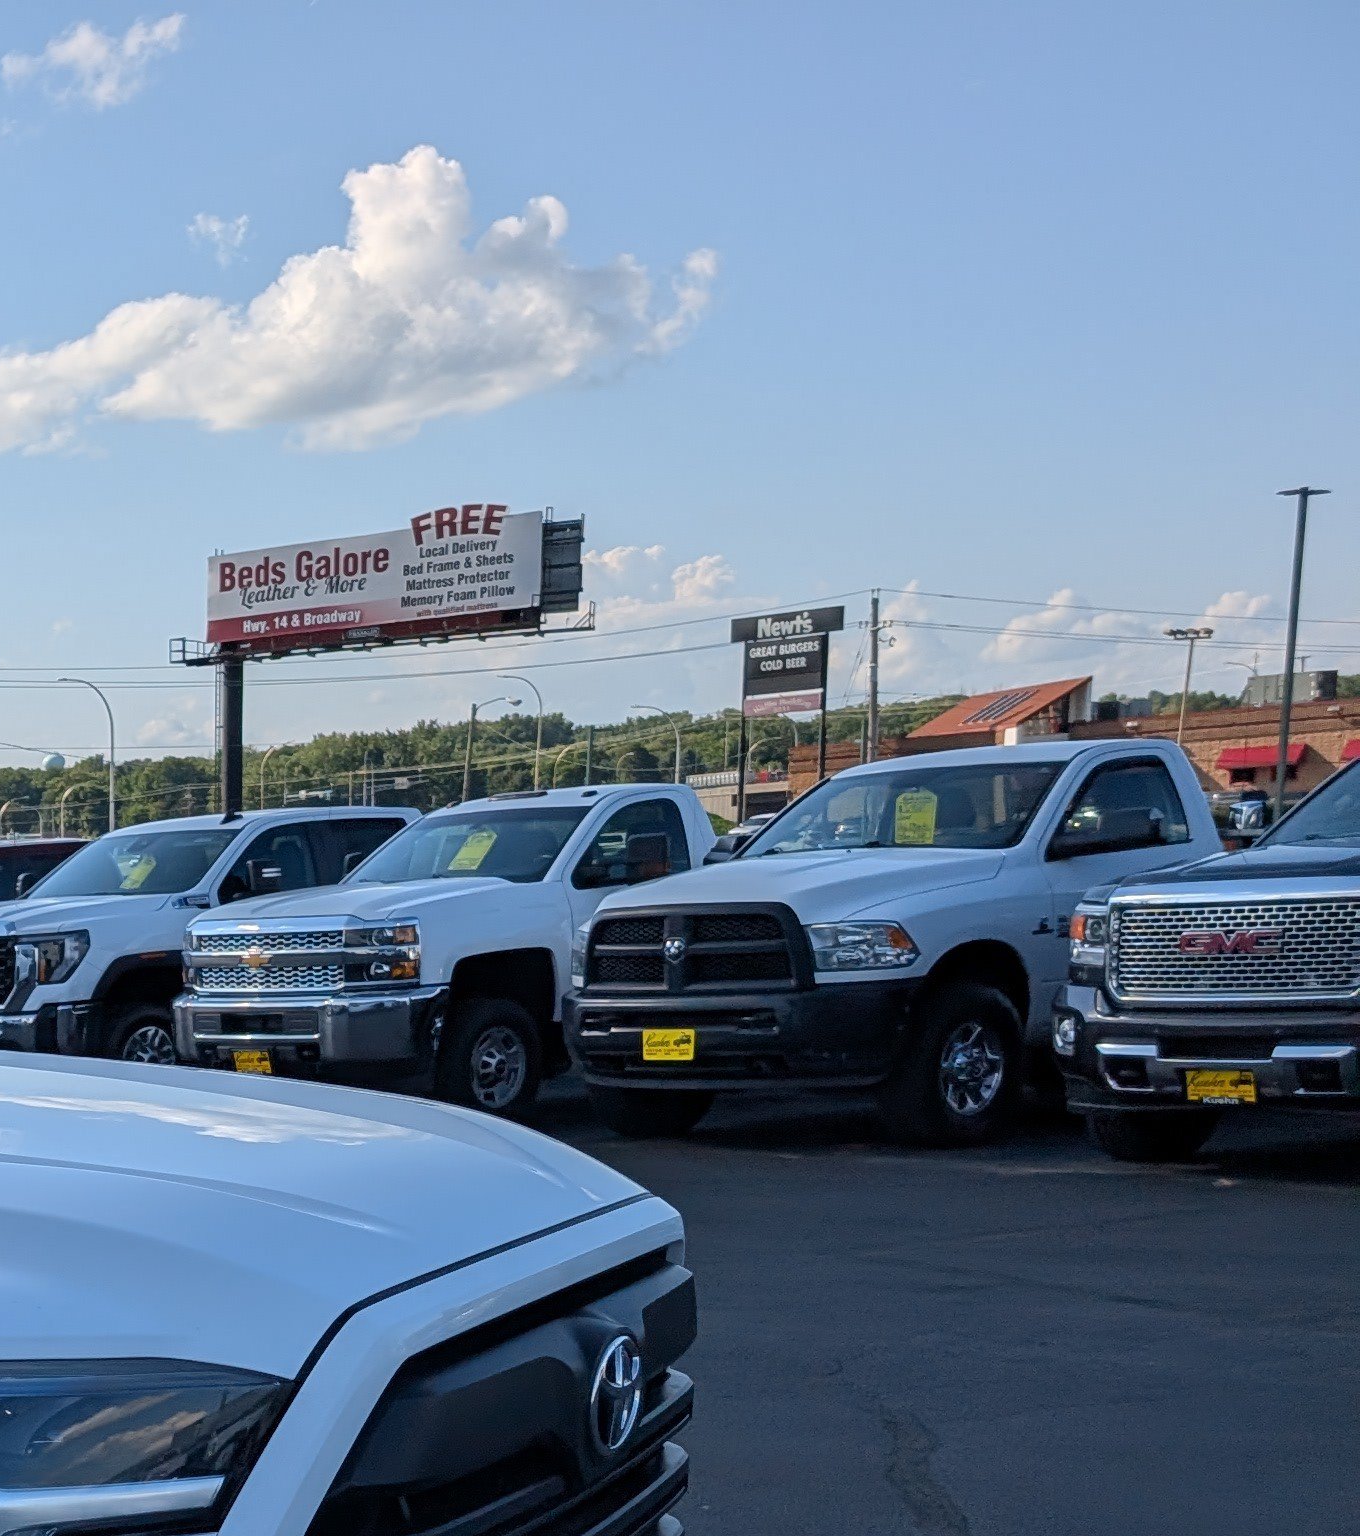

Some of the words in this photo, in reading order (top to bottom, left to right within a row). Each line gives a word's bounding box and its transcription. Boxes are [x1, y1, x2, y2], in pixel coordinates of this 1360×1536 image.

[410, 503, 508, 546] FREE
[419, 543, 449, 559] Local
[452, 539, 498, 554] Delivery
[219, 556, 286, 593] Beds
[295, 547, 390, 583] Galore
[403, 563, 424, 576] Bed
[426, 560, 460, 574] Frame
[463, 556, 472, 569] &
[475, 552, 515, 568] Sheets
[239, 584, 300, 609] Leather
[304, 577, 318, 597] &
[324, 575, 367, 595] More
[406, 577, 454, 592] Mattress
[457, 570, 511, 586] Protector
[401, 594, 444, 608] Memory
[447, 590, 477, 603] Foam
[480, 585, 516, 599] Pillow
[242, 620, 270, 634] Hwy.
[274, 616, 288, 629] 14
[291, 614, 300, 628] &
[304, 609, 362, 627] Broadway
[757, 611, 814, 638] Newt's
[749, 645, 778, 658] GREAT
[779, 641, 820, 656] BURGERS
[760, 659, 784, 672] COLD
[786, 656, 807, 669] BEER
[1179, 929, 1285, 955] GMC
